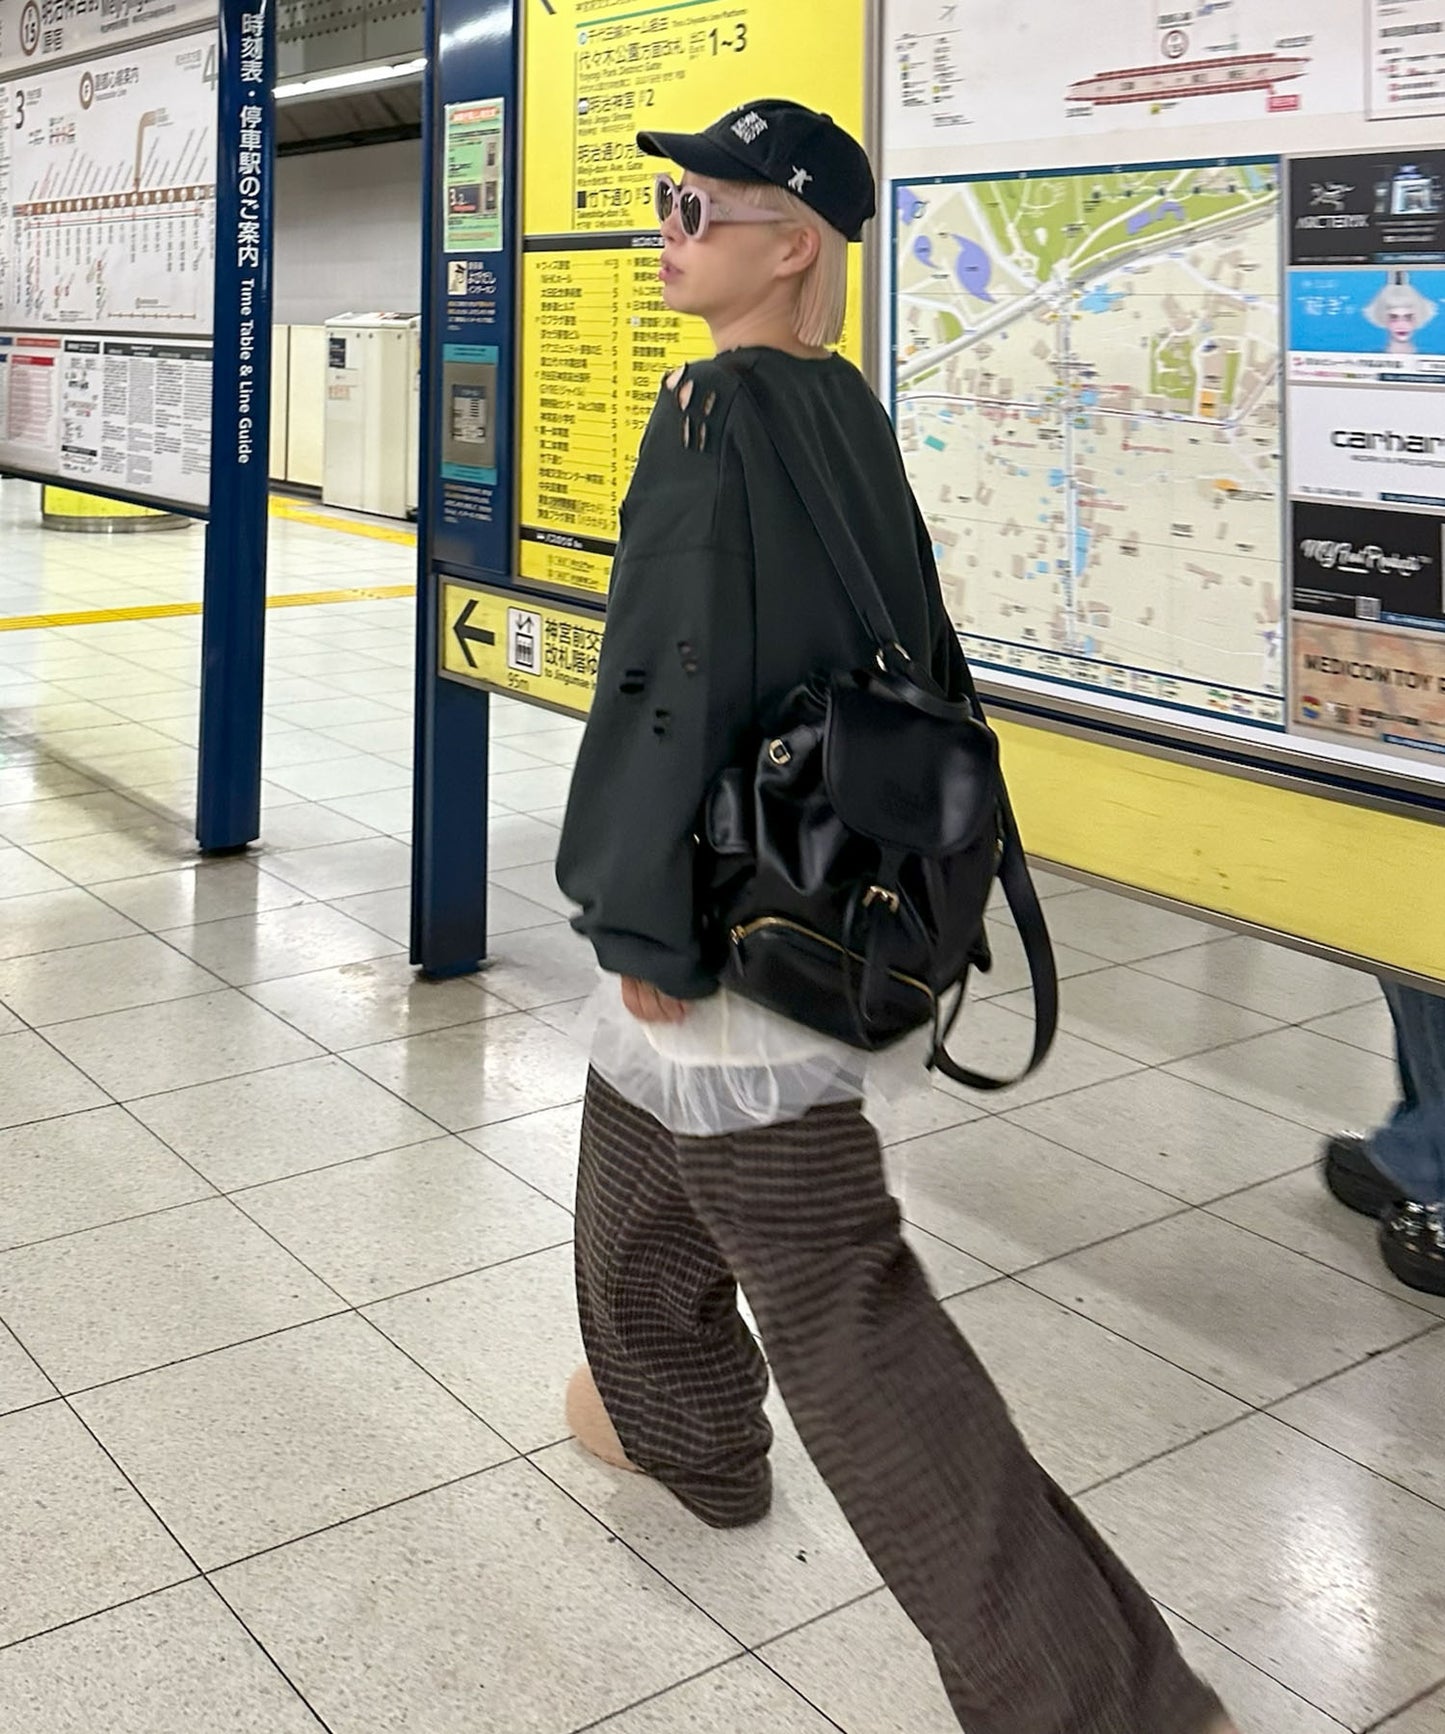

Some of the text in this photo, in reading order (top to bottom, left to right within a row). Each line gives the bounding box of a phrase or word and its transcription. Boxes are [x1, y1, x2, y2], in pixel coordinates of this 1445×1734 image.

[25, 22, 36, 43] 15
[202, 44, 218, 91] 4
[15, 90, 25, 130] 3
[646, 89, 655, 107] 2
[237, 13, 264, 268] 時刻表・停車駅のご案内
[642, 186, 652, 205] 5
[238, 278, 255, 464] Time Table & Line Guide
[1304, 653, 1392, 685] MEDICOM
[1393, 668, 1434, 692] TOY
